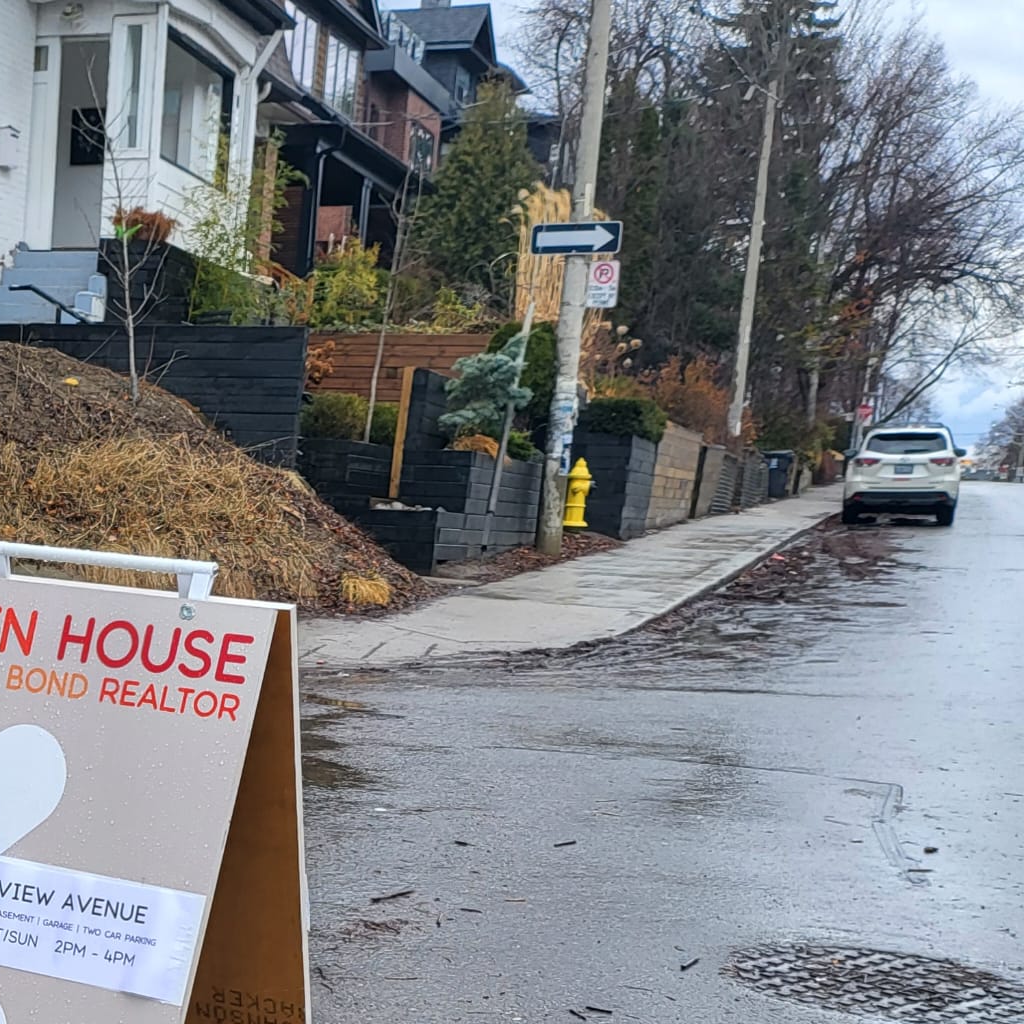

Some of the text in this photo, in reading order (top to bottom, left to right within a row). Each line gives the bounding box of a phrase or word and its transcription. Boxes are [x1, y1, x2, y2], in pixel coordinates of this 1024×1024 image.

[57, 614, 255, 685] HOUSE
[6, 664, 89, 699] BOND
[99, 677, 241, 721] REALTOR
[61, 893, 149, 924] AVENUE
[42, 919, 74, 931] GARAGE
[83, 926, 102, 937] TWO
[104, 930, 122, 941] CAR
[124, 934, 157, 947] PARKING
[54, 939, 87, 958] 2PM
[104, 949, 136, 967] 4PM
